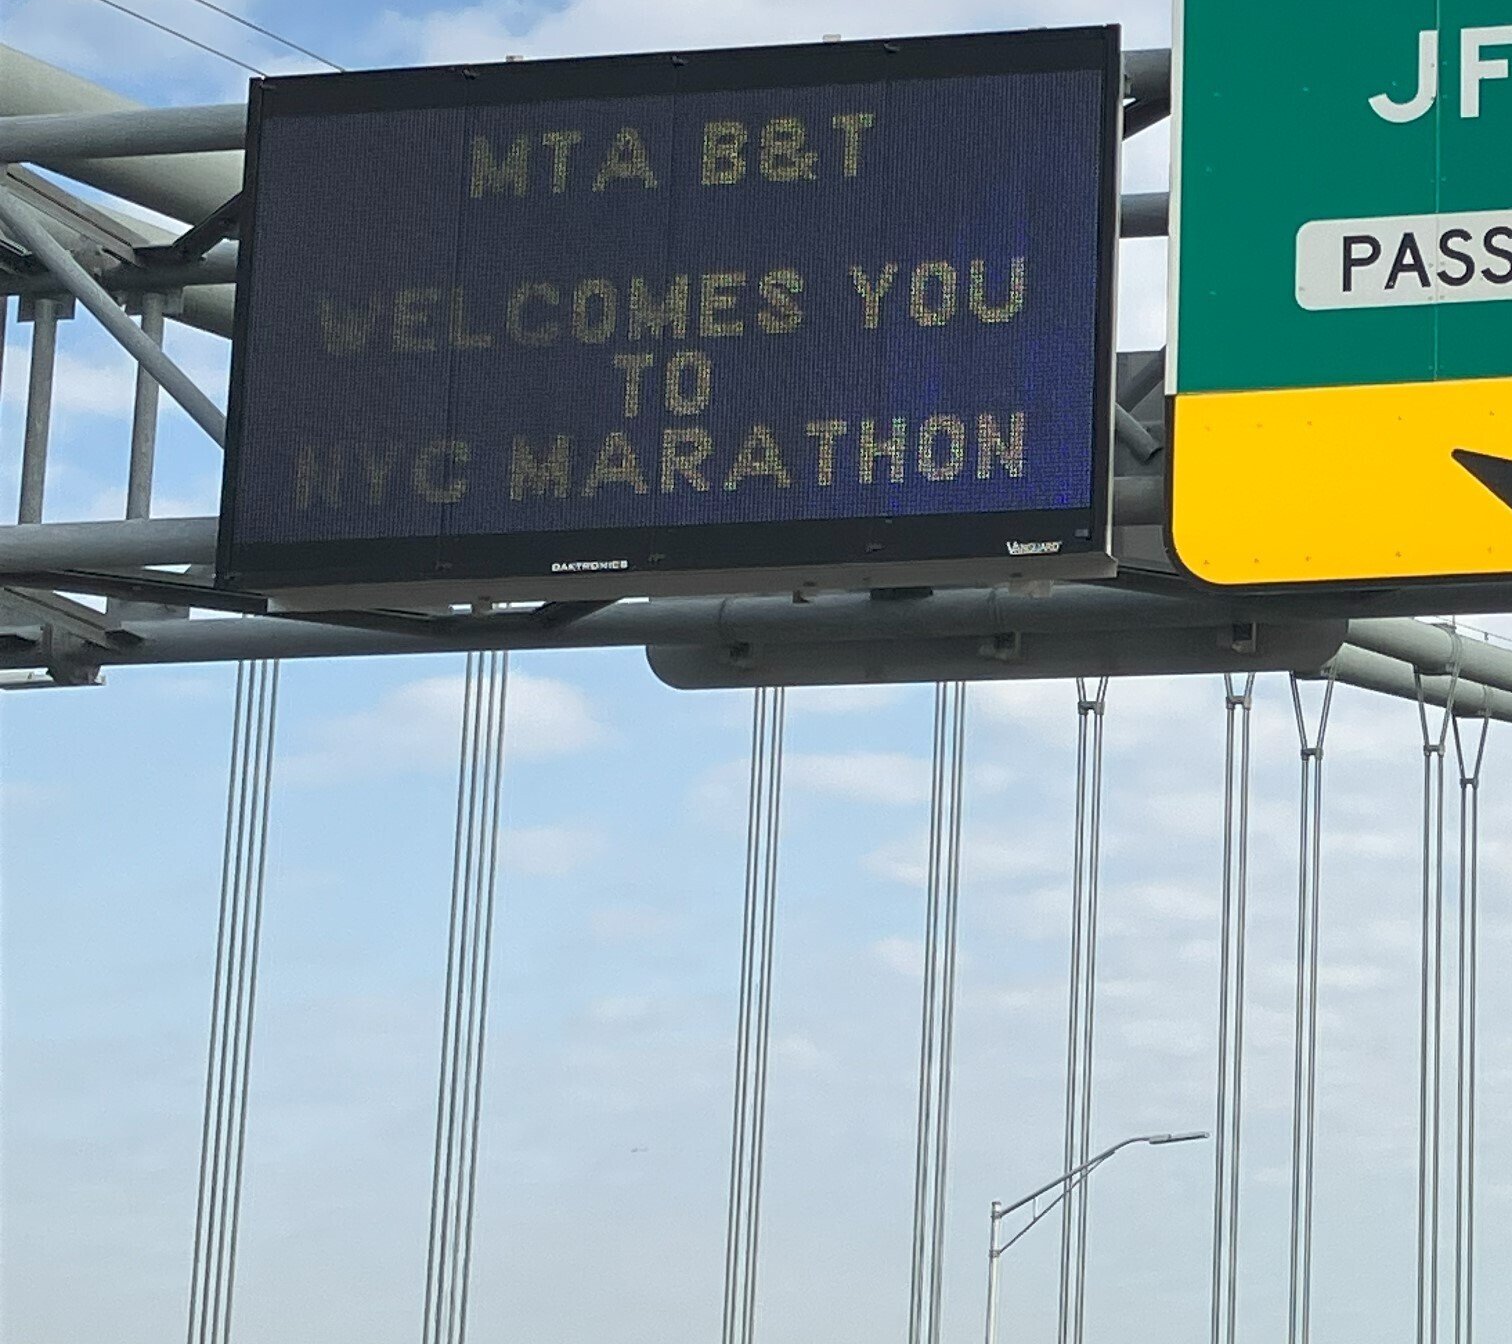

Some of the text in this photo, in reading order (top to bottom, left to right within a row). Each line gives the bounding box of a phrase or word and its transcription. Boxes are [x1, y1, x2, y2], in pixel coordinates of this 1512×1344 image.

[470, 113, 874, 198] MTA B&T
[319, 257, 1025, 352] WELCOMES YOU
[613, 351, 711, 418] TO
[296, 411, 1026, 510] NYC MARATHON
